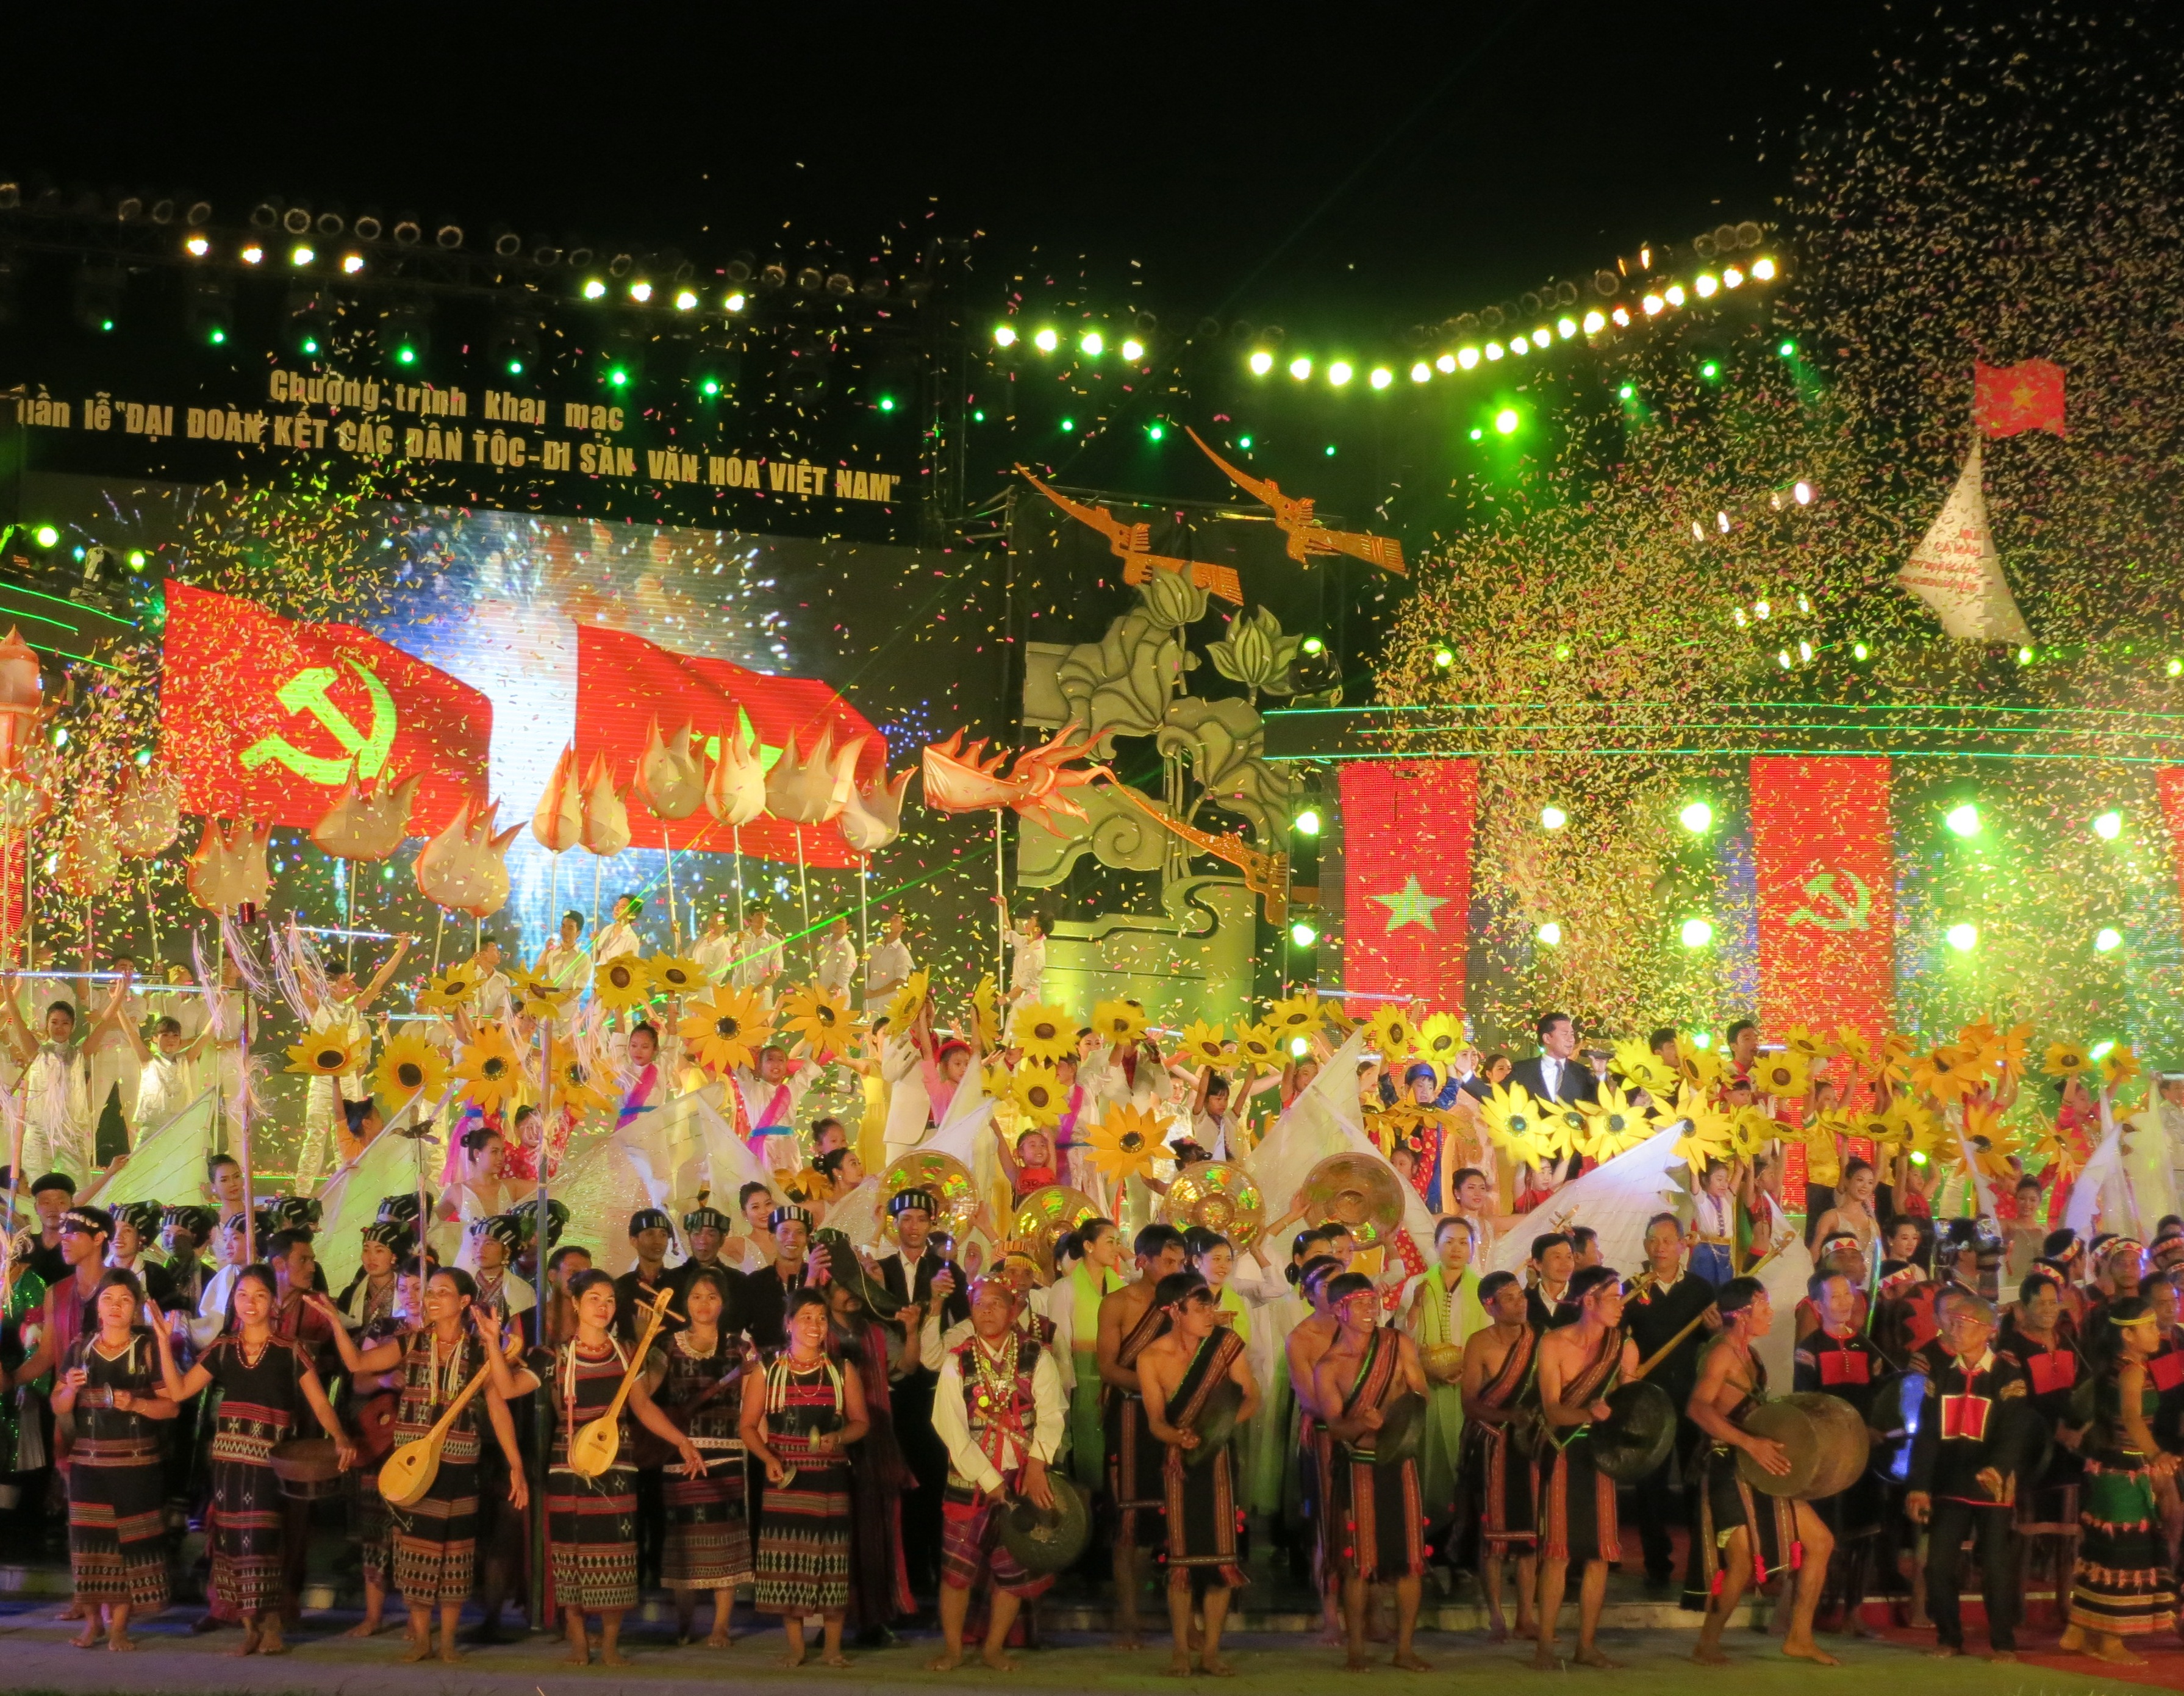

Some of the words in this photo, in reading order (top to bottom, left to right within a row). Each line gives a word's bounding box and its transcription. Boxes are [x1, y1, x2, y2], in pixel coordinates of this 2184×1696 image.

[85, 391, 112, 431] lễ
[187, 403, 261, 443] ĐOÀN
[274, 407, 328, 449] KẾT
[338, 416, 393, 455] CÁC
[406, 422, 462, 462] DÂN
[580, 437, 634, 476] SẢN
[647, 445, 698, 483] VĂN
[709, 448, 761, 489] HÓA
[769, 459, 828, 501] VIỆT
[565, 403, 624, 438] mạc
